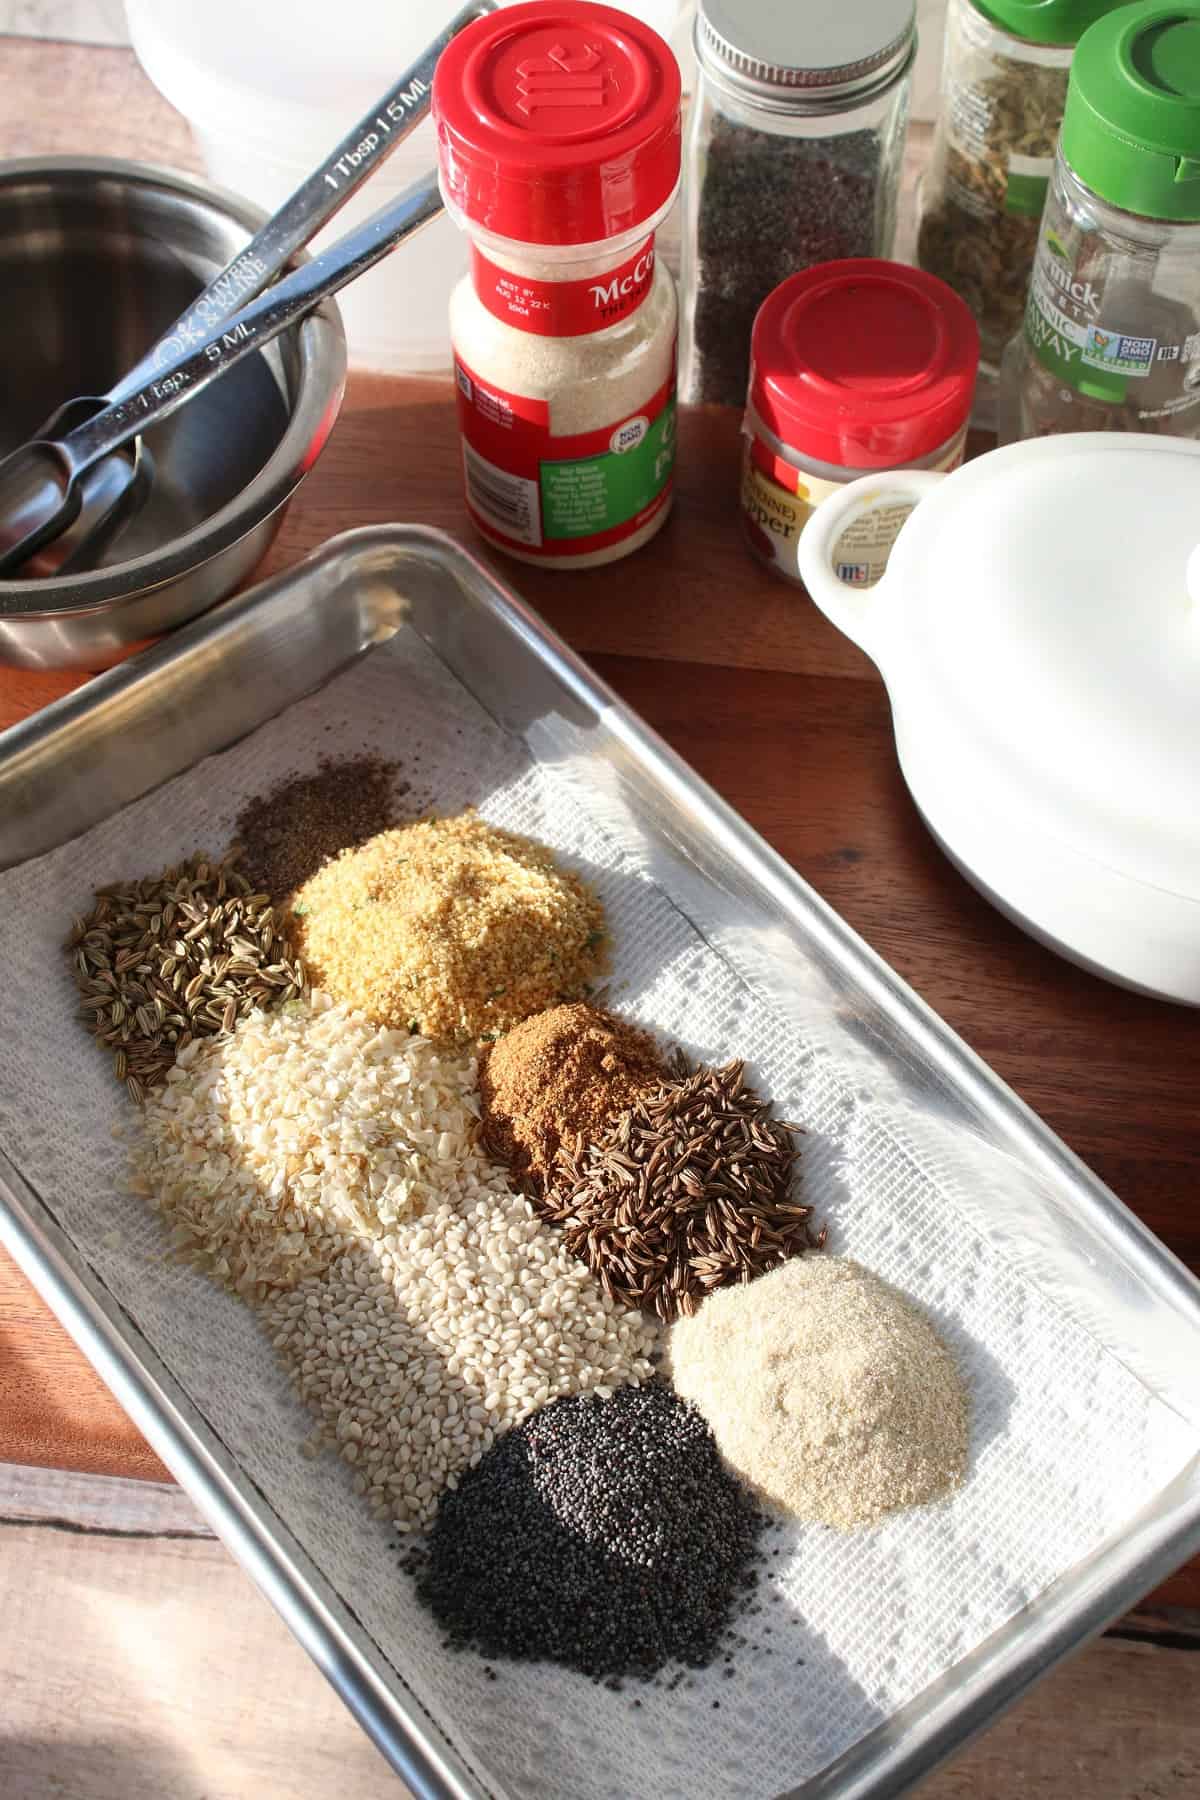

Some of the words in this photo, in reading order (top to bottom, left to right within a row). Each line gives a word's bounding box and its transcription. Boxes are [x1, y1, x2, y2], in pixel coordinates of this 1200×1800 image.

[334, 132, 379, 176] Tbsp
[399, 77, 431, 107] ML
[1122, 339, 1152, 350] NON
[1119, 346, 1151, 356] GMO
